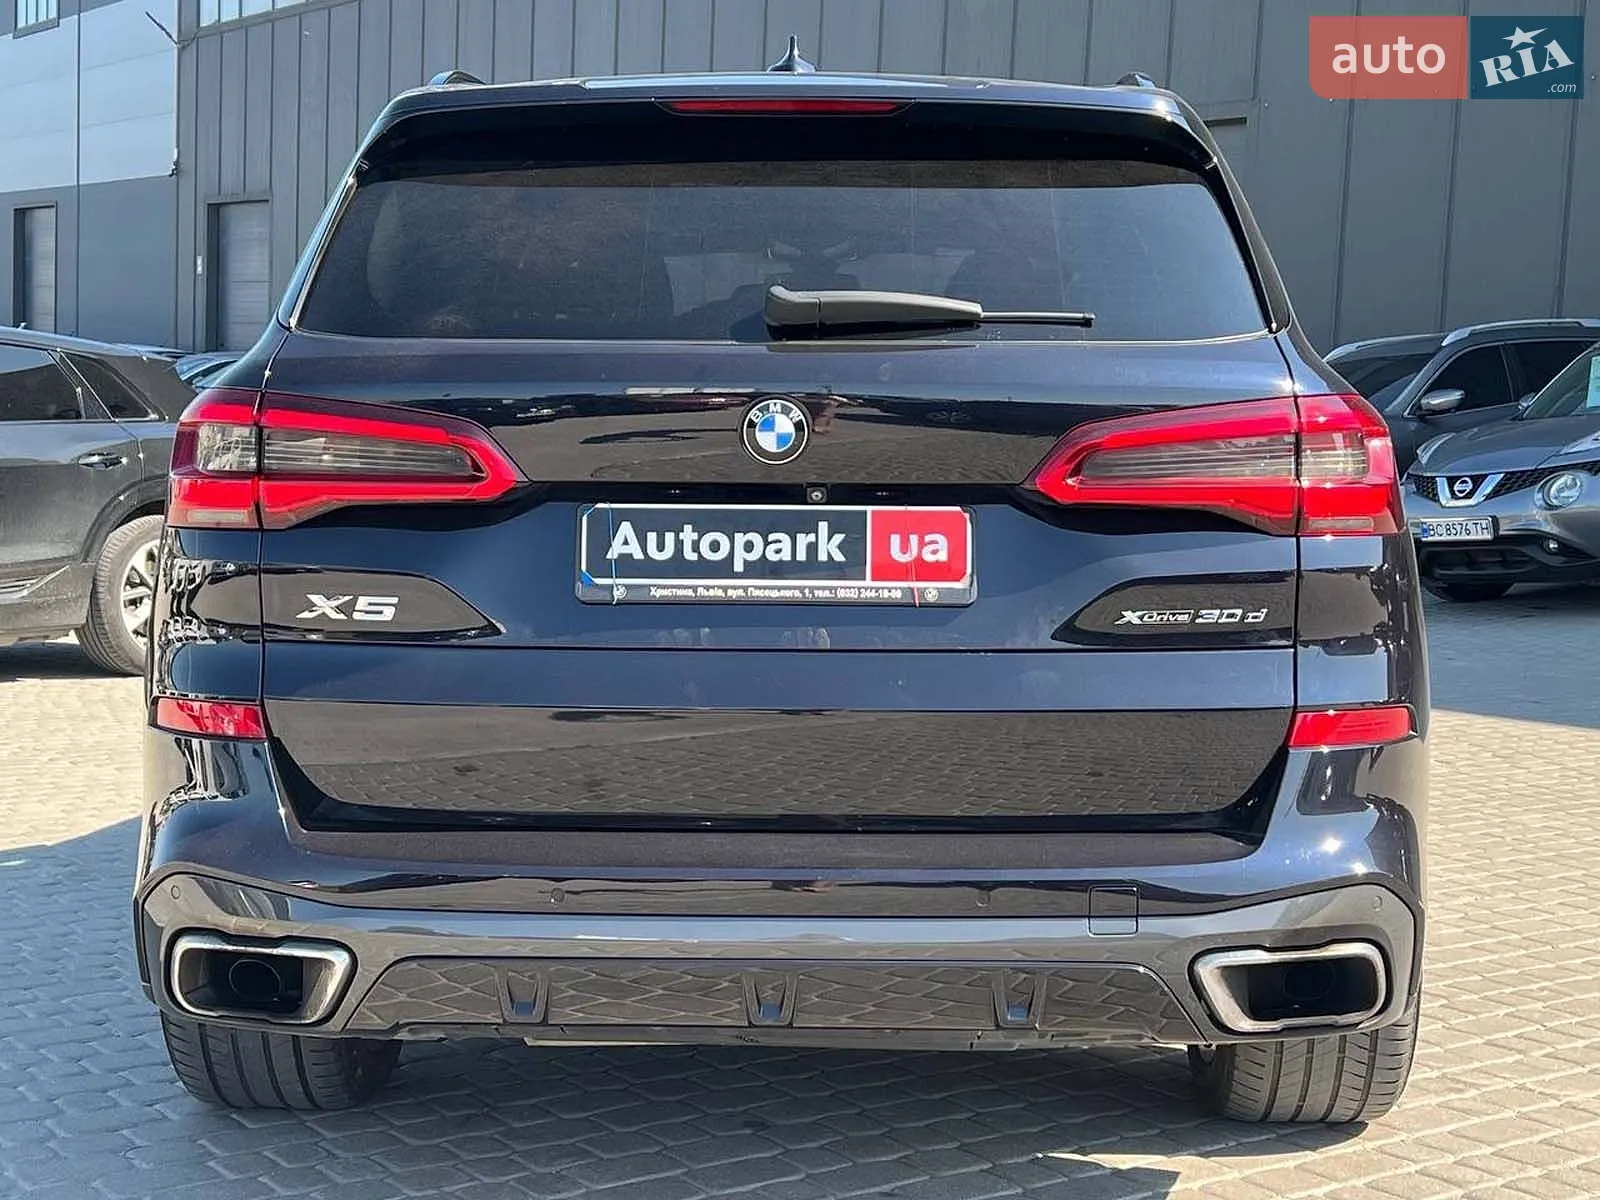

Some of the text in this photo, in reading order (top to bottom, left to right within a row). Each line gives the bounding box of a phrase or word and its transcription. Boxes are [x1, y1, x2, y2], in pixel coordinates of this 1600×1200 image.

[750, 402, 802, 424] BMW
[606, 520, 949, 573] Autopark ua
[295, 594, 400, 621] X5
